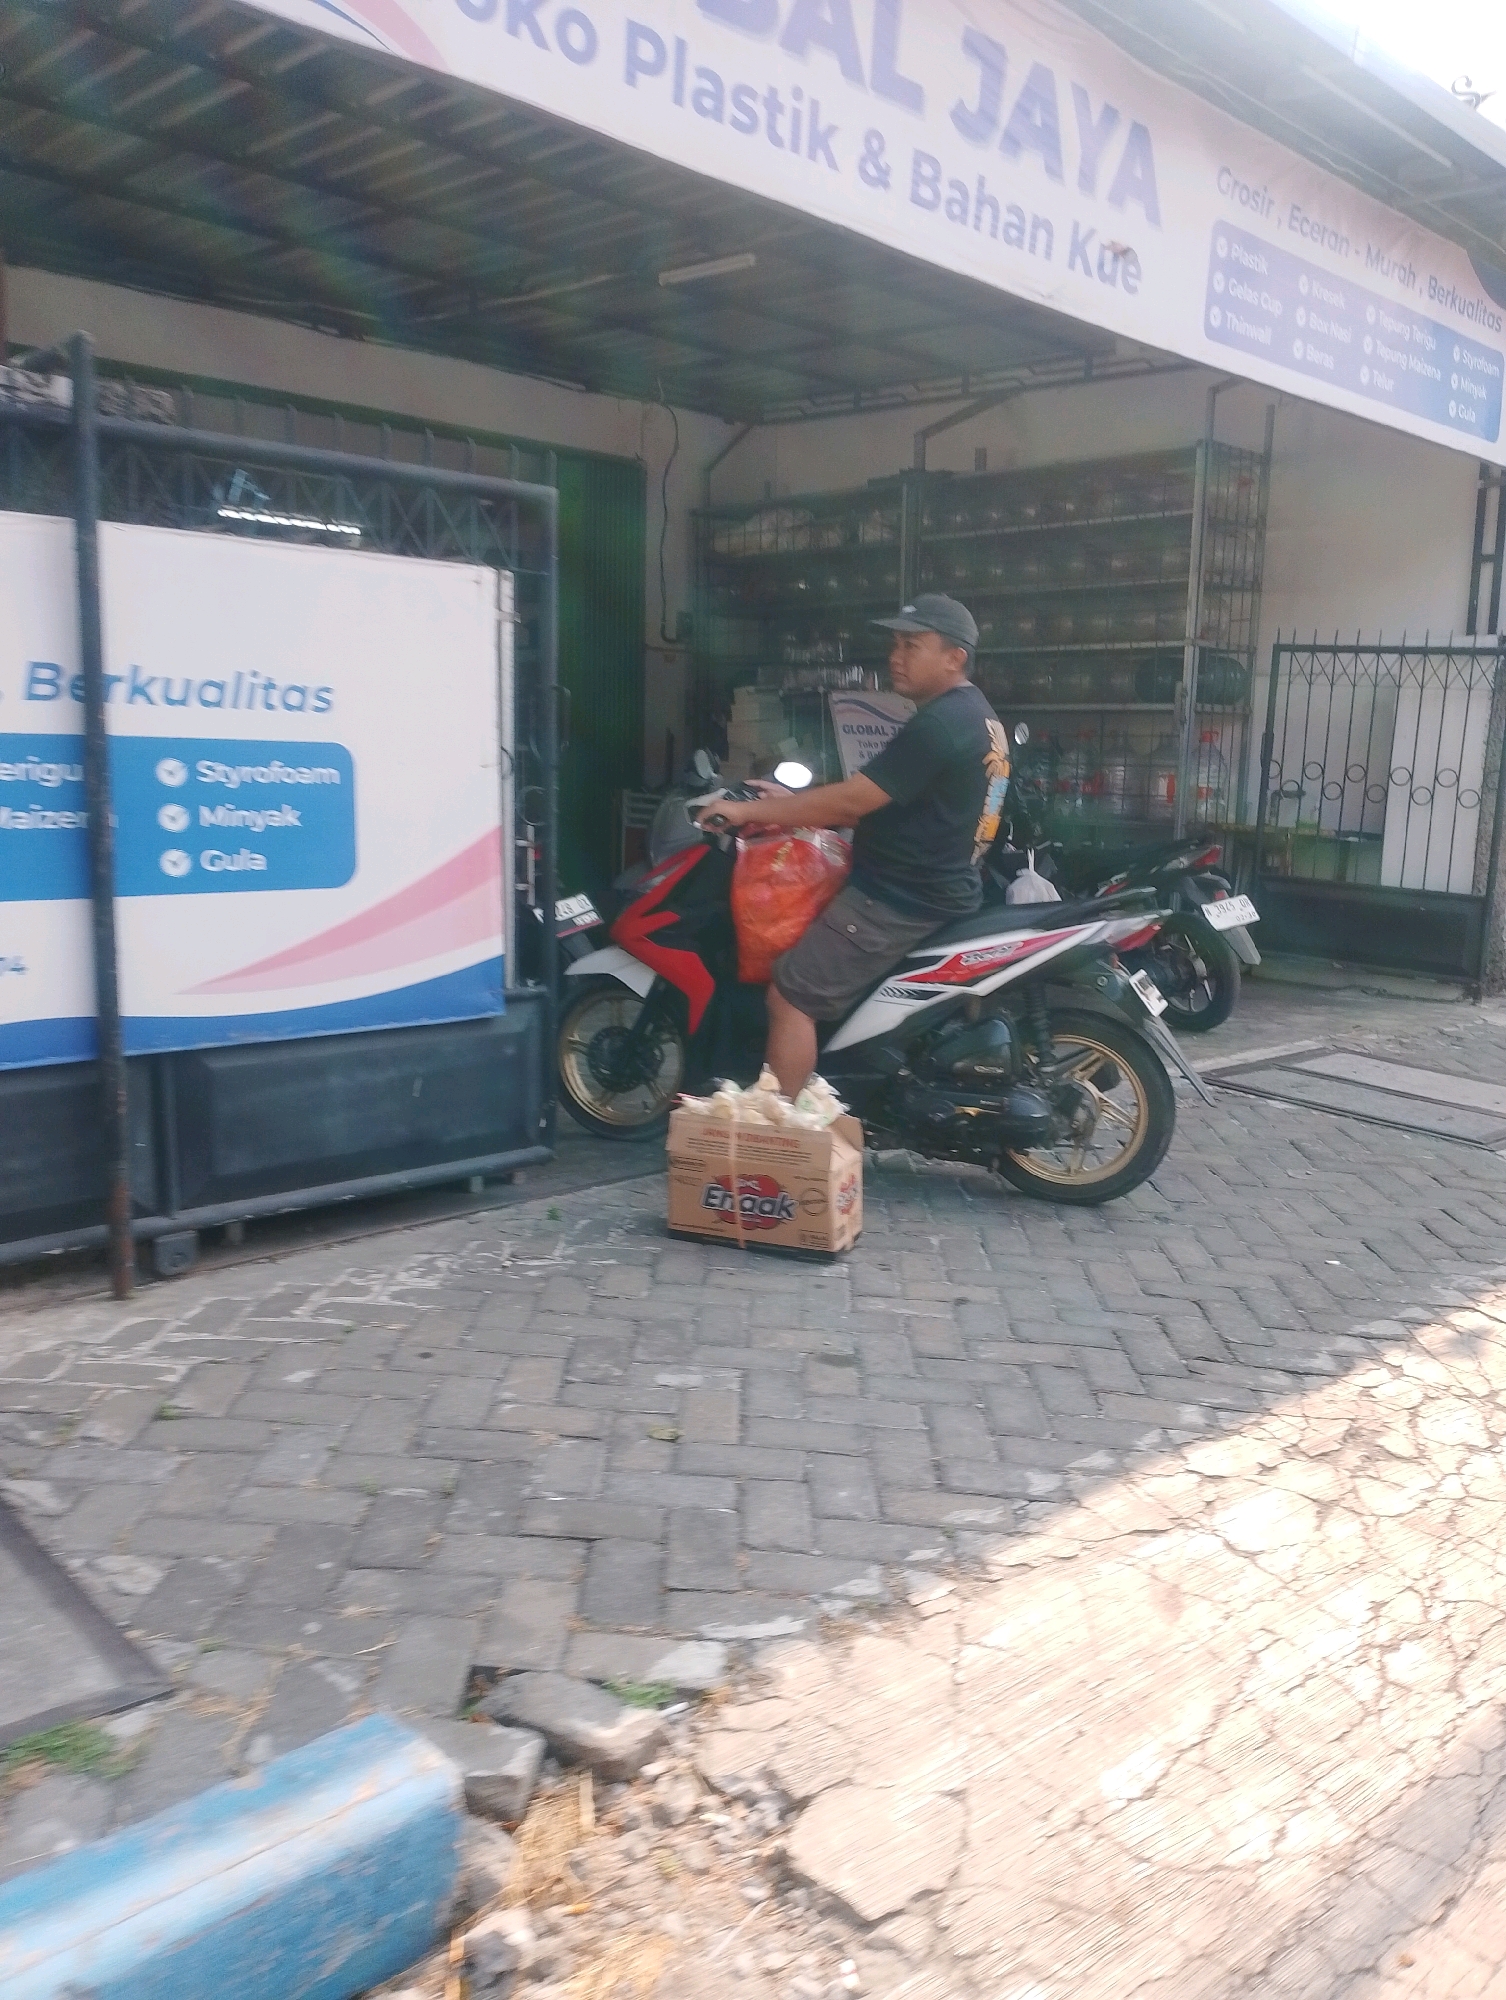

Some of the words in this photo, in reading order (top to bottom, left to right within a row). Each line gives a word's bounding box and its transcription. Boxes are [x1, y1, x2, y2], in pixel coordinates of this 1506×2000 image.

[949, 25, 1163, 231] JAYA
[622, 18, 841, 174] Plastik
[858, 128, 893, 191] &
[909, 148, 1056, 261] Bahan
[1067, 219, 1143, 296] Kue
[1217, 165, 1275, 219] Grosir
[1287, 202, 1351, 258] Eceran
[1365, 241, 1416, 290] Murah
[1427, 274, 1503, 333] Berkualitas
[1230, 242, 1269, 276] Plastik
[1259, 291, 1283, 318] Cup
[1462, 349, 1500, 378] Styrofoam
[1460, 375, 1487, 401] Minyak
[1458, 403, 1476, 424] Gula
[195, 759, 341, 789] Styrofoam
[198, 802, 303, 833] Minyak
[199, 848, 268, 872] Gula
[702, 1183, 799, 1221] Enaak
